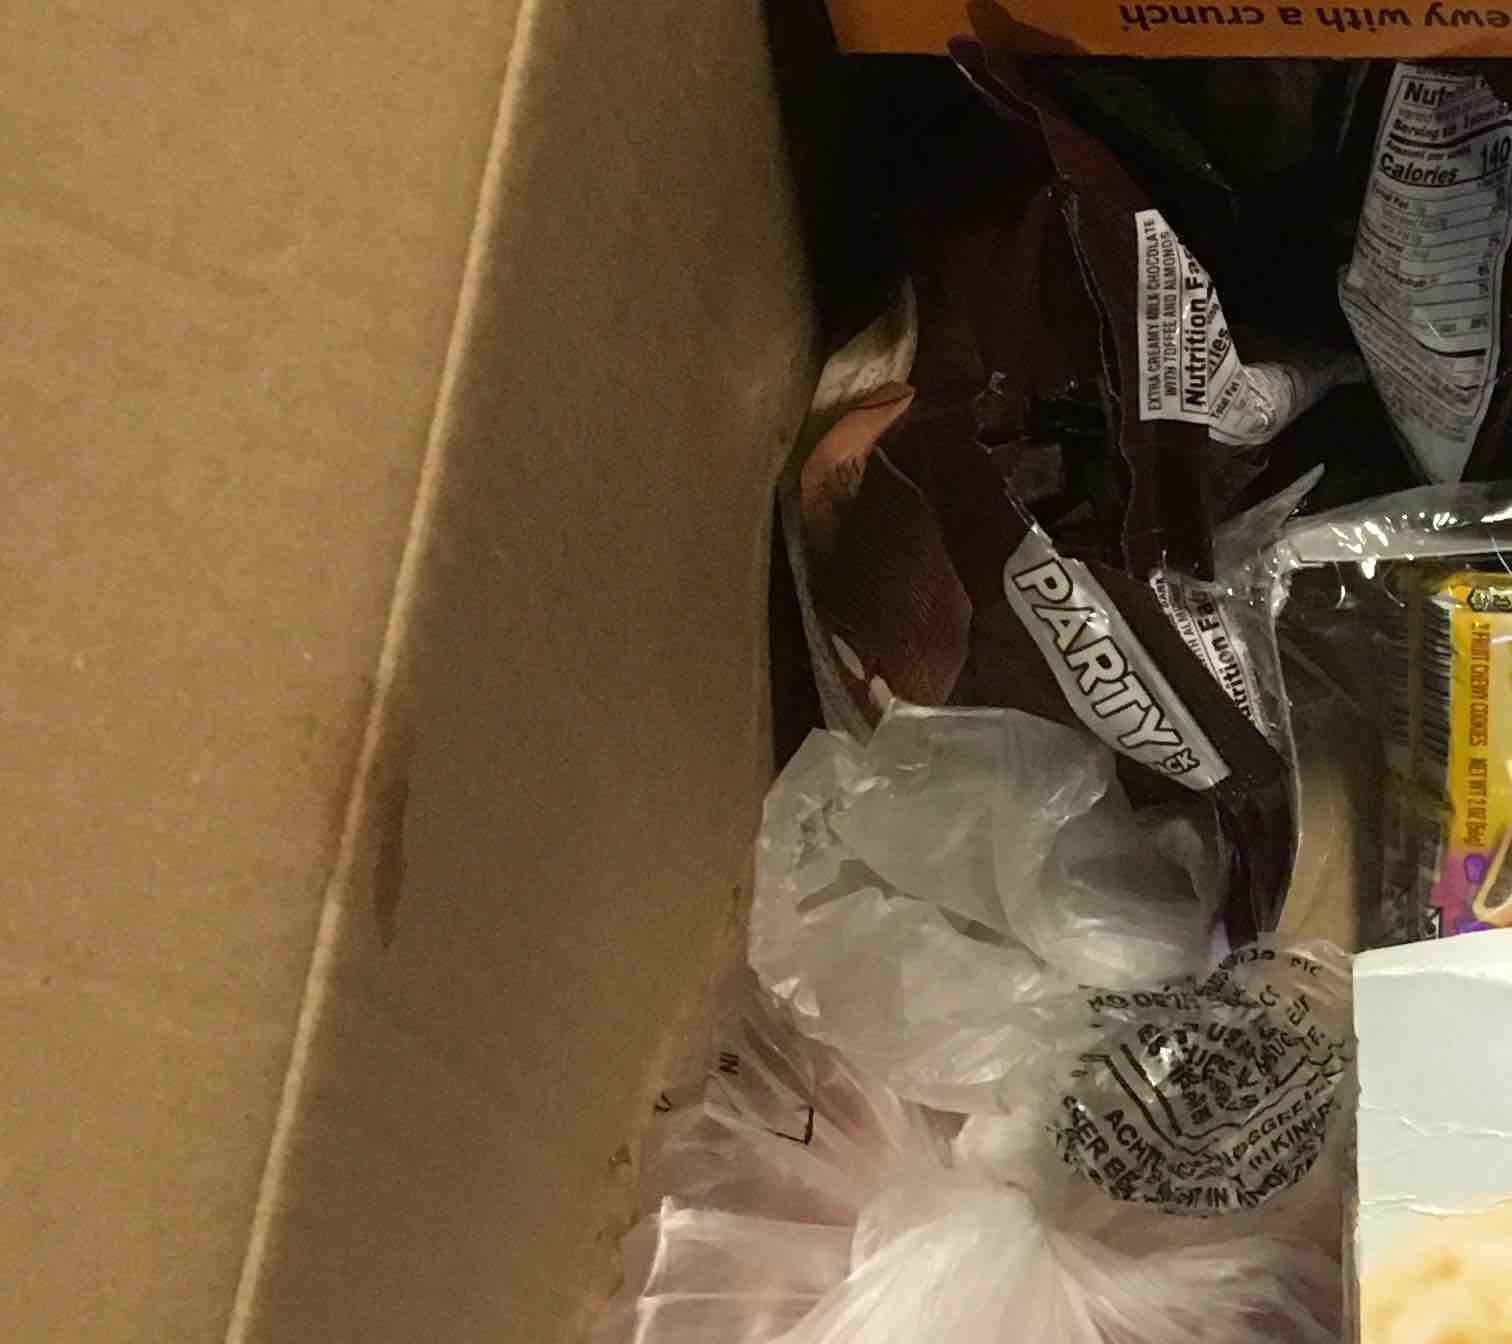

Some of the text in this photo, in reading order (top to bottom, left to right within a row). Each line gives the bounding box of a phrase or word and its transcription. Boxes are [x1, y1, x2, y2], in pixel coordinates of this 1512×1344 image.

[1119, 2, 1264, 31] crunch
[1277, 5, 1301, 28] a
[1315, 4, 1410, 31] with
[1378, 152, 1460, 187] Calories
[1143, 323, 1165, 410] EXTRA CREAMY
[1185, 300, 1206, 406] Nutrition
[1012, 558, 1183, 744] PARTY
[1463, 630, 1493, 748] FRUIT CHEWY COOKIES
